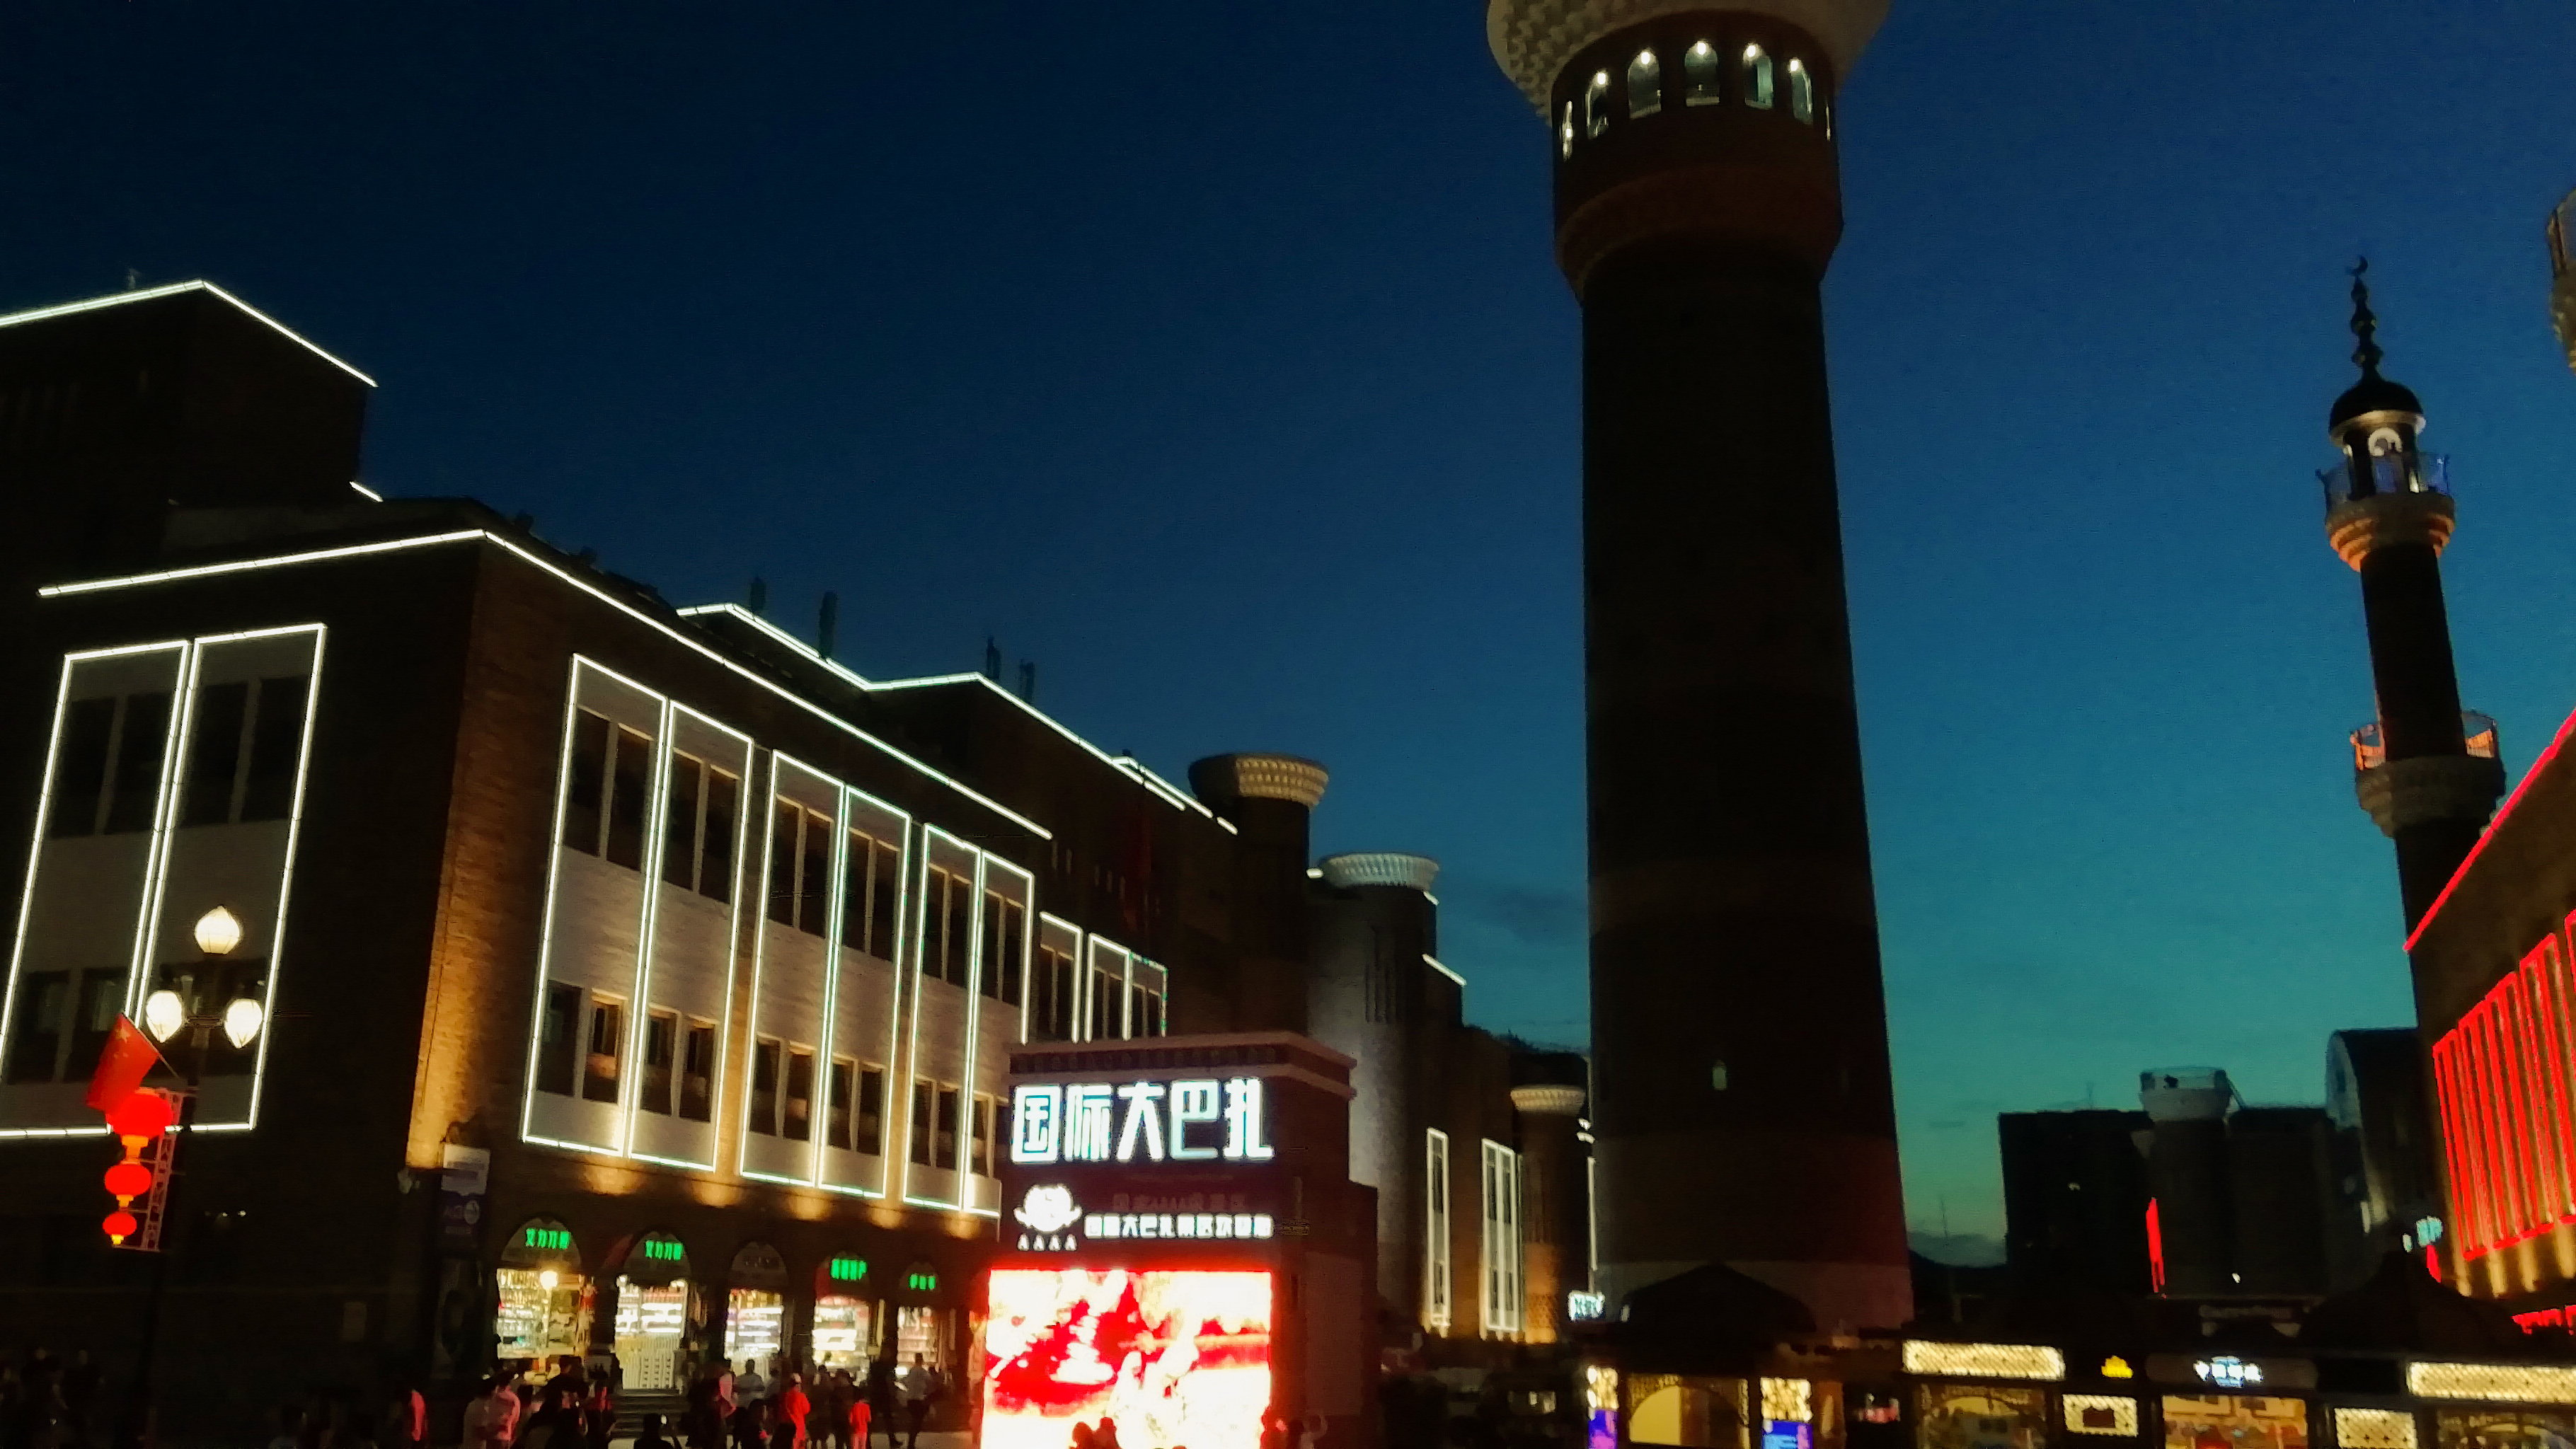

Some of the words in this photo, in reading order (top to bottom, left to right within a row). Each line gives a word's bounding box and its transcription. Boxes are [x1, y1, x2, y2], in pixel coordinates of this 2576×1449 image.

[1011, 1078, 1275, 1163] 国际大巴扎
